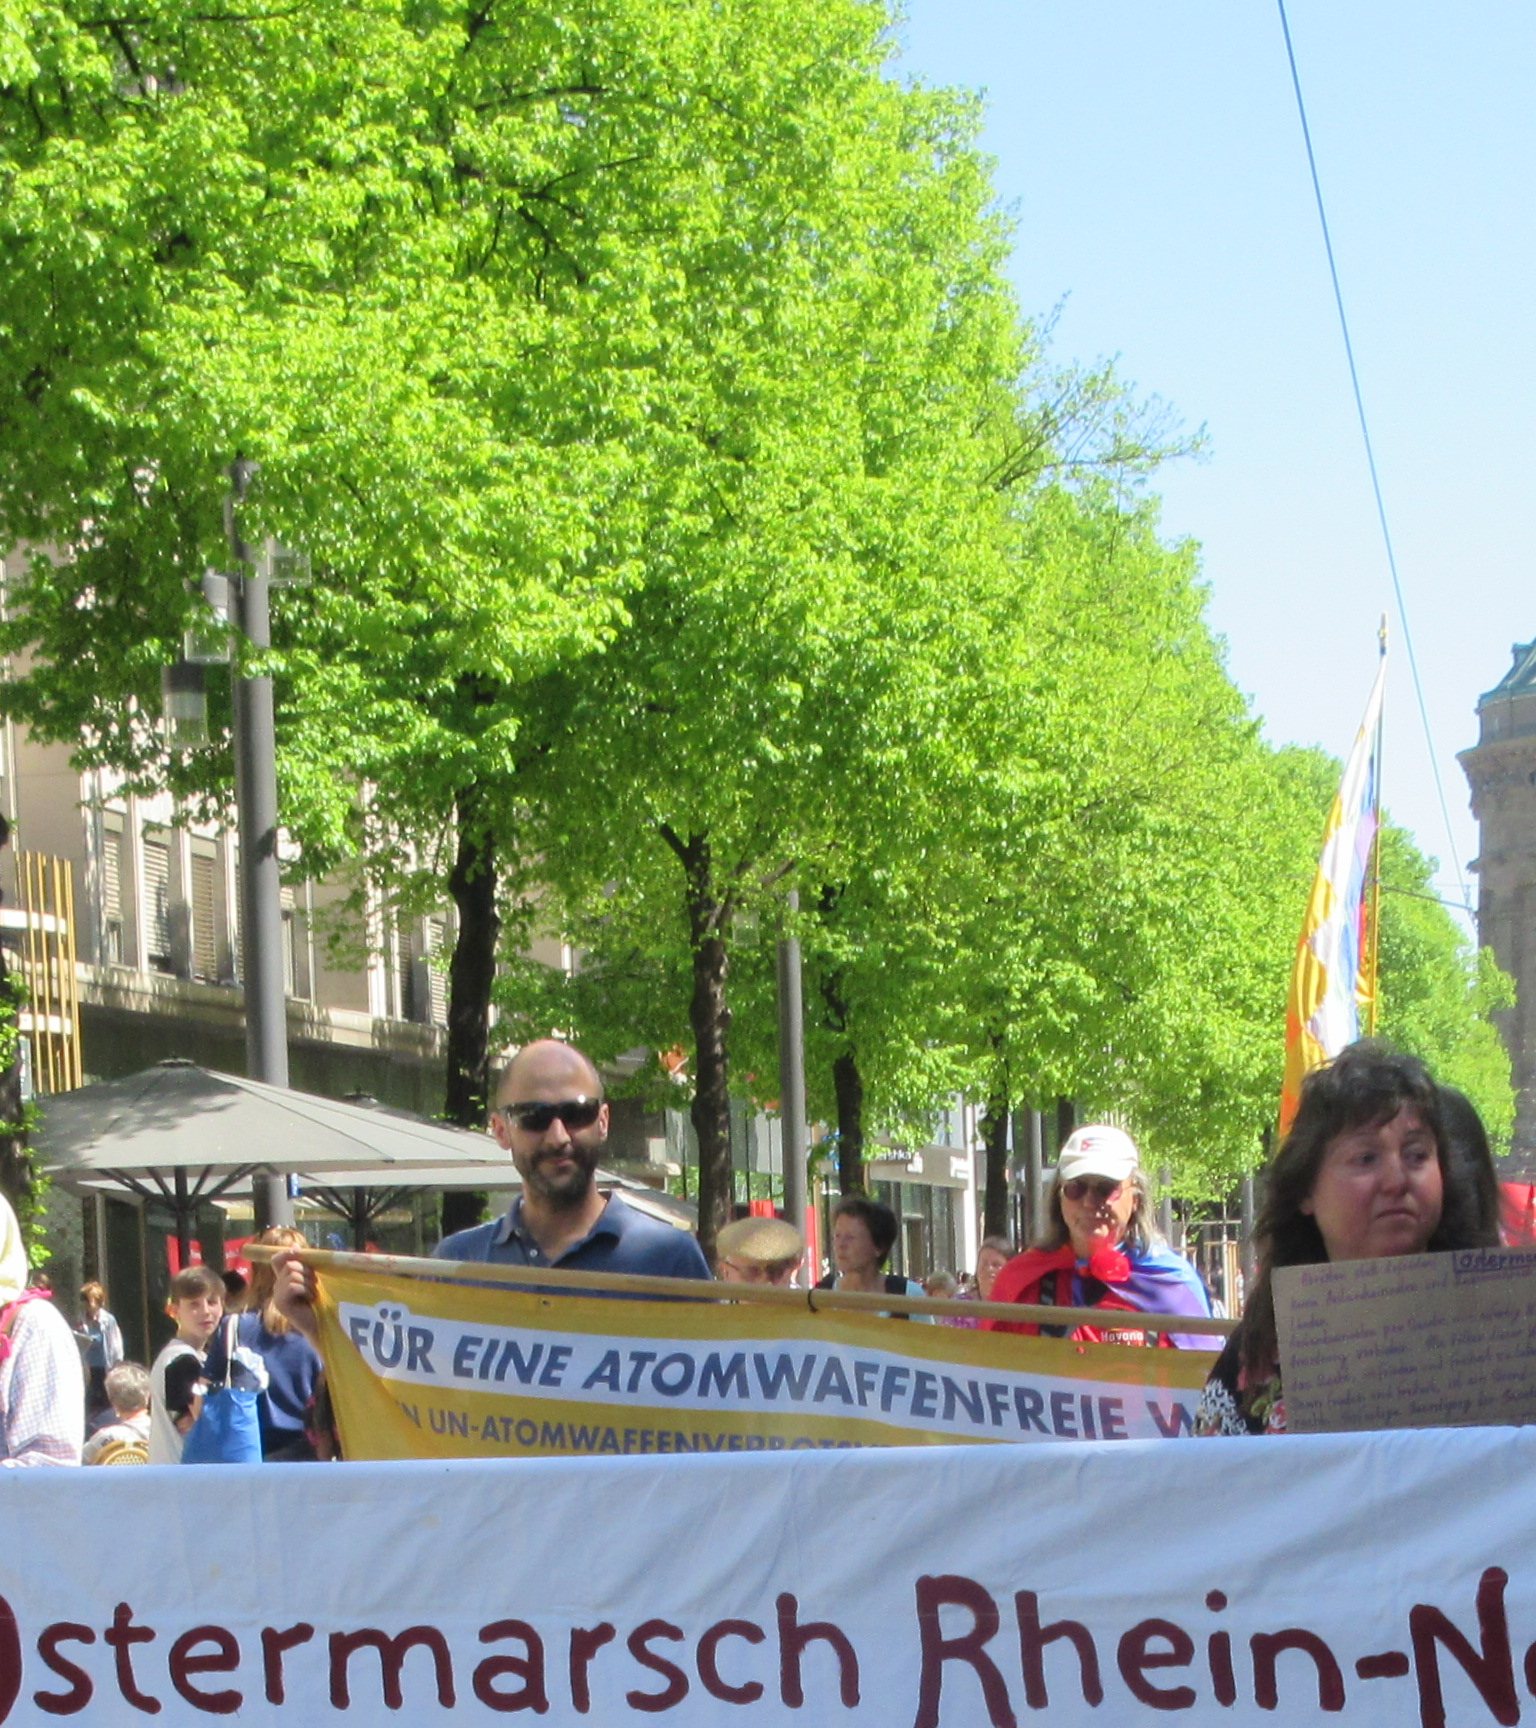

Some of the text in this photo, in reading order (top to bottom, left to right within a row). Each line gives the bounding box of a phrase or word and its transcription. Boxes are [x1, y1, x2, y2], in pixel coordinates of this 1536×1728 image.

[348, 1307, 435, 1374] FÜR
[453, 1335, 573, 1388] EINE
[582, 1349, 1130, 1440] ATOMWAFFENFREIE
